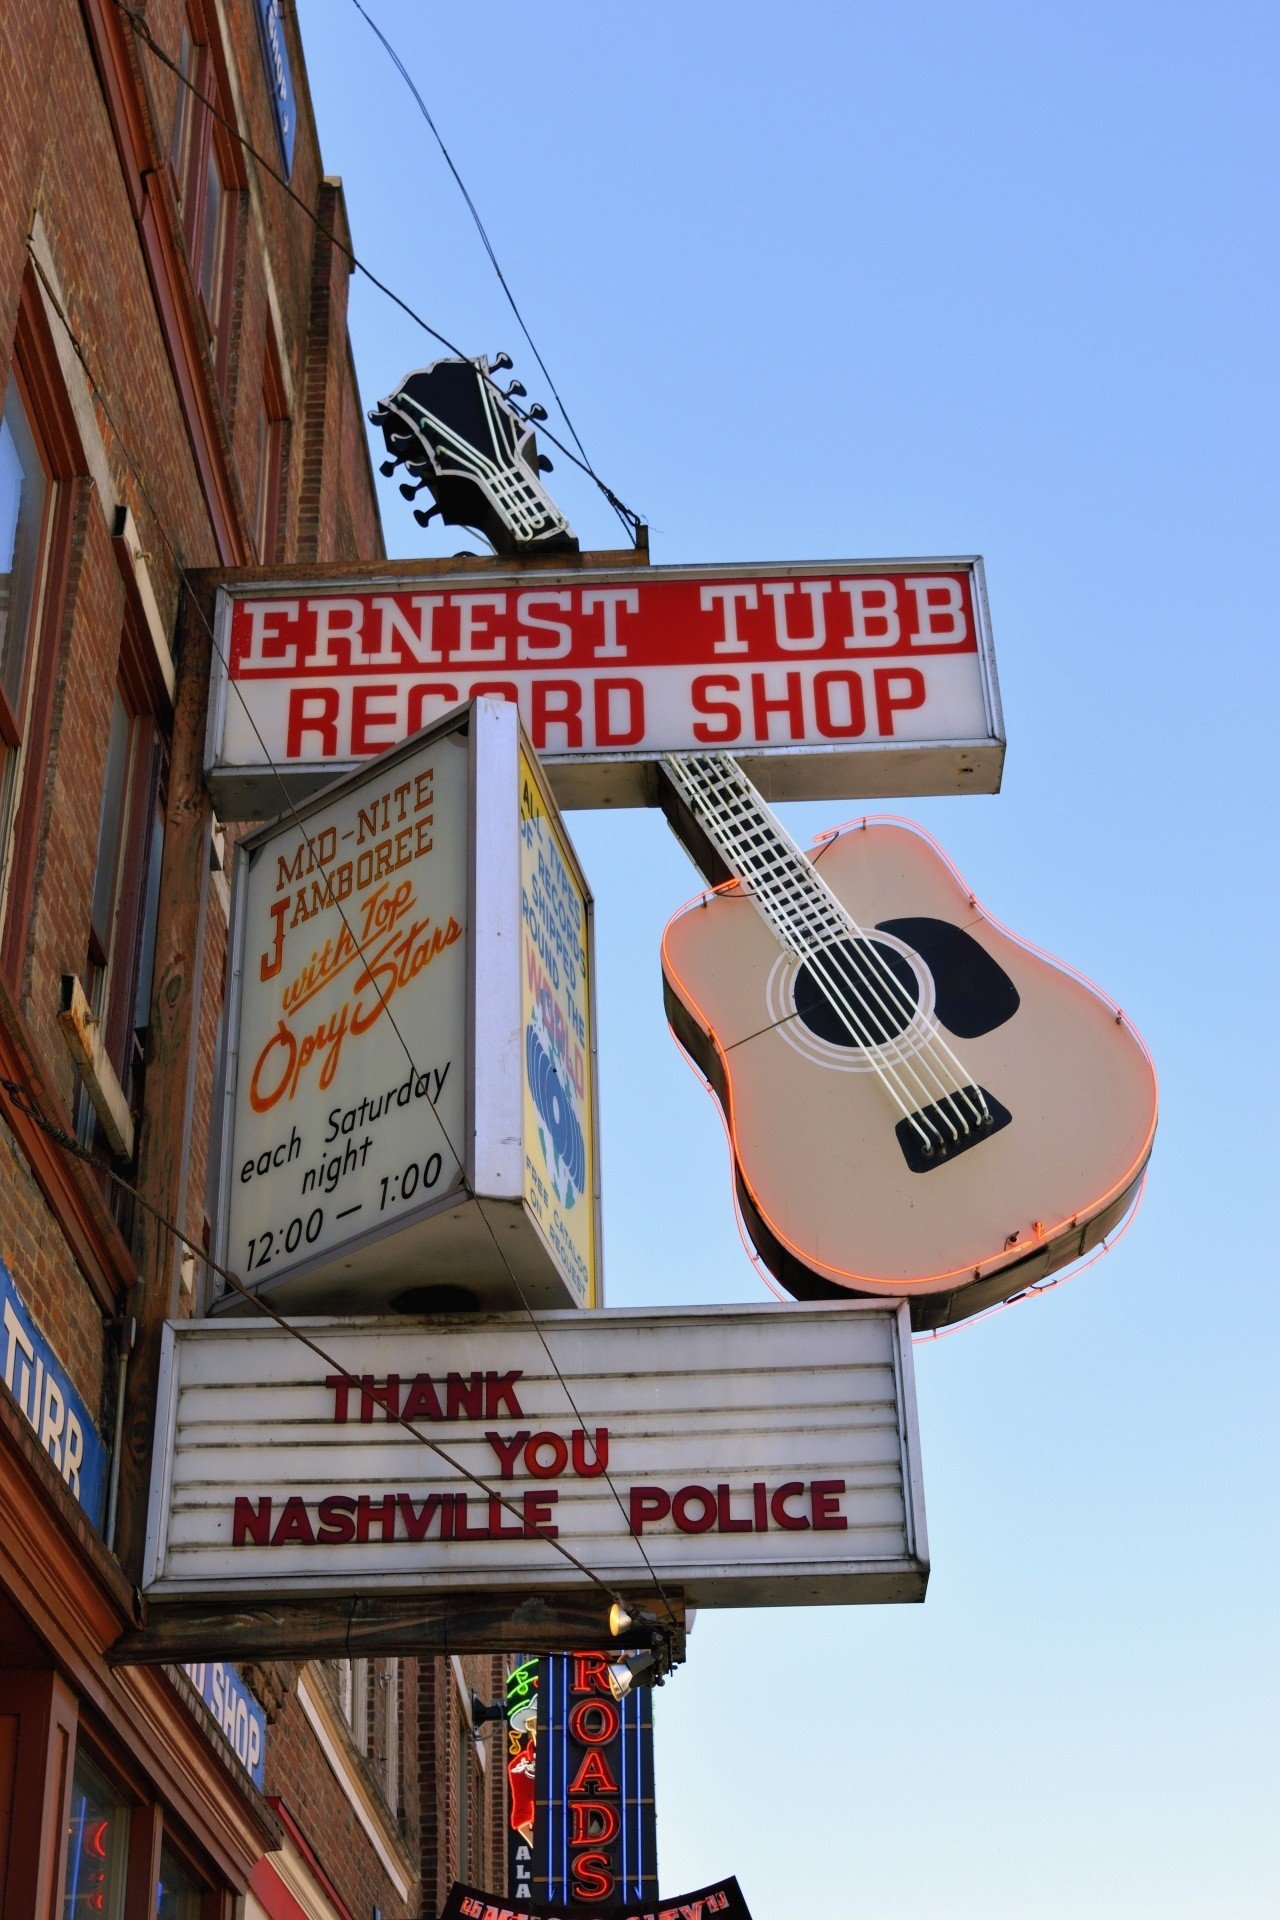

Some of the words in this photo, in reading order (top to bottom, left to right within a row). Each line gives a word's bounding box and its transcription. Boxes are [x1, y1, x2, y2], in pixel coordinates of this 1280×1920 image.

[239, 588, 640, 670] ERNEST
[700, 577, 967, 654] TUBB
[691, 666, 927, 743] SHOP
[276, 768, 434, 892] MID-NITE
[522, 779, 543, 843] ALL
[549, 836, 581, 931] TYPES
[261, 814, 434, 983] JAMBOREE
[282, 918, 354, 1011] with
[360, 880, 418, 942] Top
[531, 873, 577, 991] SHIPPED
[538, 848, 587, 980] RECORDS
[250, 1001, 350, 1114] Opry
[352, 916, 463, 1035] Stars
[525, 933, 585, 1101] WORLD
[565, 985, 586, 1050] THE
[240, 1126, 302, 1184] each
[325, 1061, 451, 1144] Saturday
[301, 1136, 373, 1194] night
[246, 1207, 324, 1272] 12:00
[380, 1152, 443, 1211] 1:00
[525, 1155, 549, 1209] FREE
[553, 1209, 589, 1284] CATALOG
[530, 1187, 542, 1219] ON
[550, 1222, 587, 1300] REQUEST
[326, 1370, 525, 1423] THANK
[485, 1427, 609, 1480] YOU
[232, 1489, 559, 1547] NASHVILLE
[629, 1479, 848, 1537] POLICE
[210, 1662, 260, 1778] SHOP
